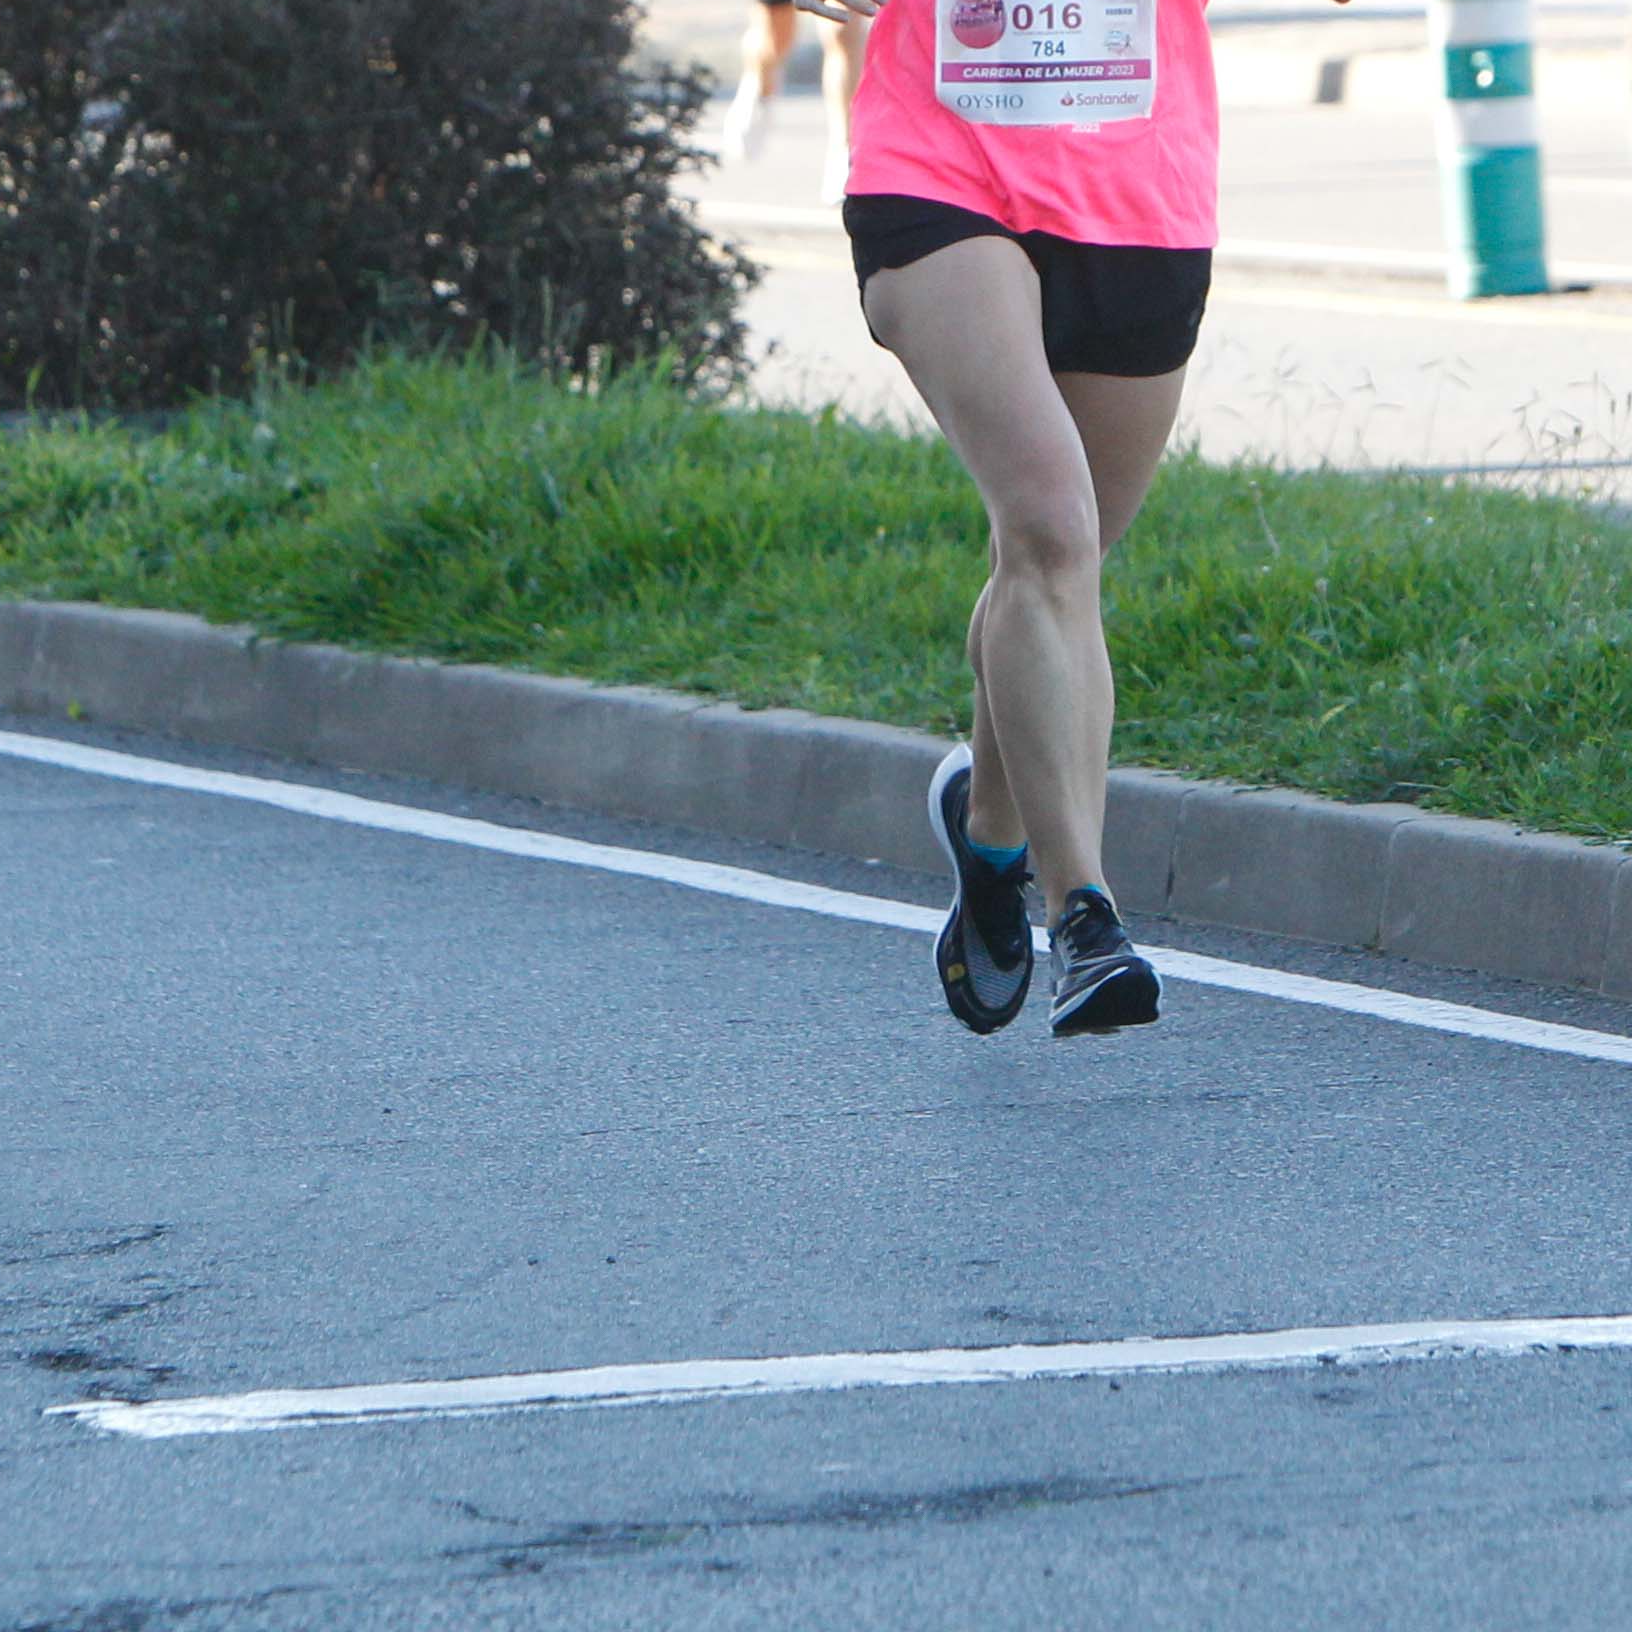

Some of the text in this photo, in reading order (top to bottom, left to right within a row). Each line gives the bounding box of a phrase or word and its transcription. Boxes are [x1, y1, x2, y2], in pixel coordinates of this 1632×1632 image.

[1012, 3, 1083, 30] 016
[1032, 40, 1066, 57] 784
[963, 64, 1136, 79] CARRERA DE LA MUJER 2023
[956, 94, 1024, 109] OYSHO
[1076, 93, 1141, 106] Santander
